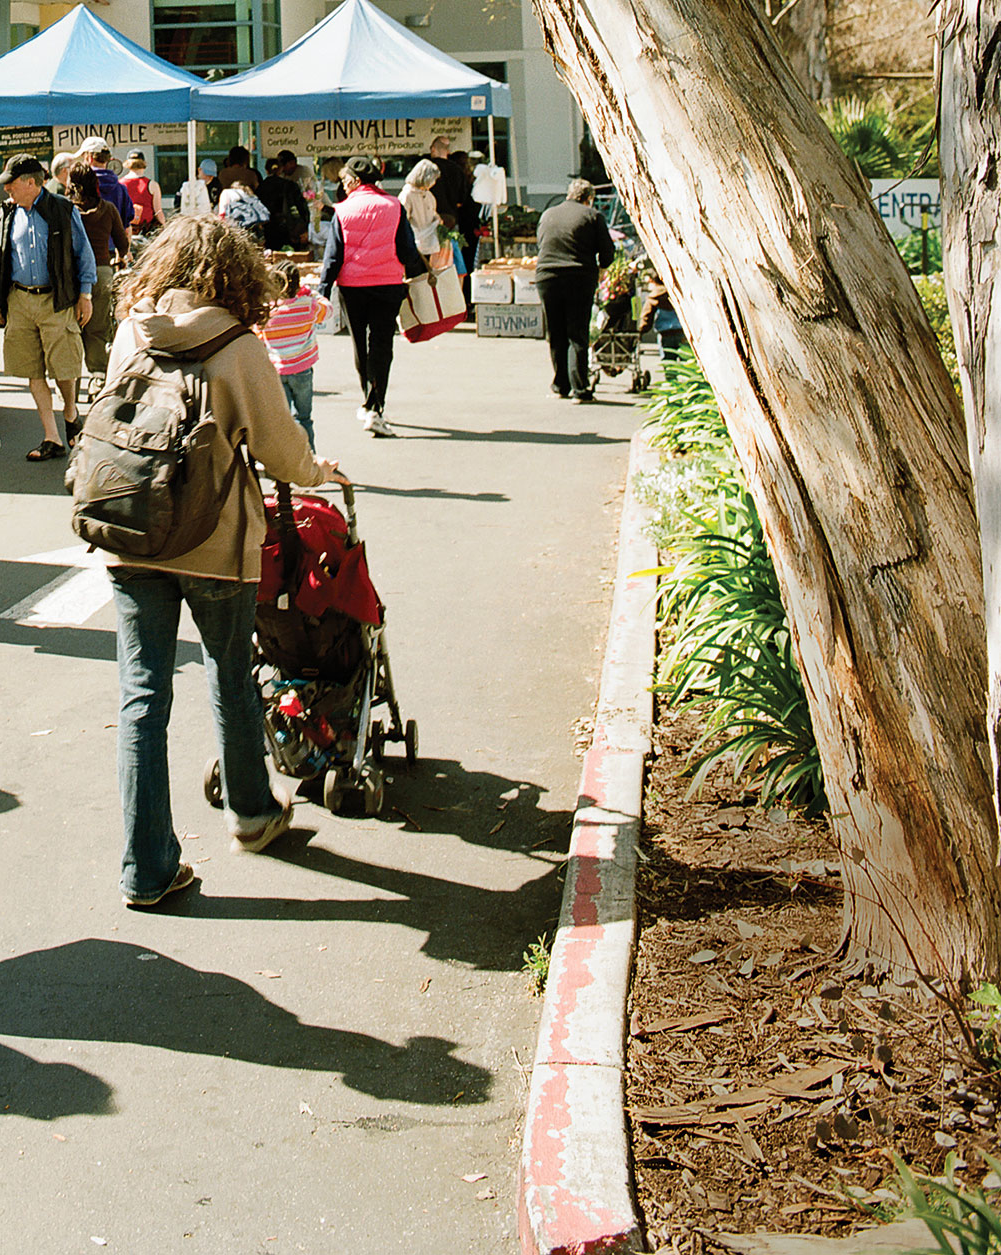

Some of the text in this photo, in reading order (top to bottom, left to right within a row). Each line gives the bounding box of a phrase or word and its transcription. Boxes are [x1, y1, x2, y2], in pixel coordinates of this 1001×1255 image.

[267, 138, 299, 147] Certified
[305, 140, 425, 153] Organically Grown Produce
